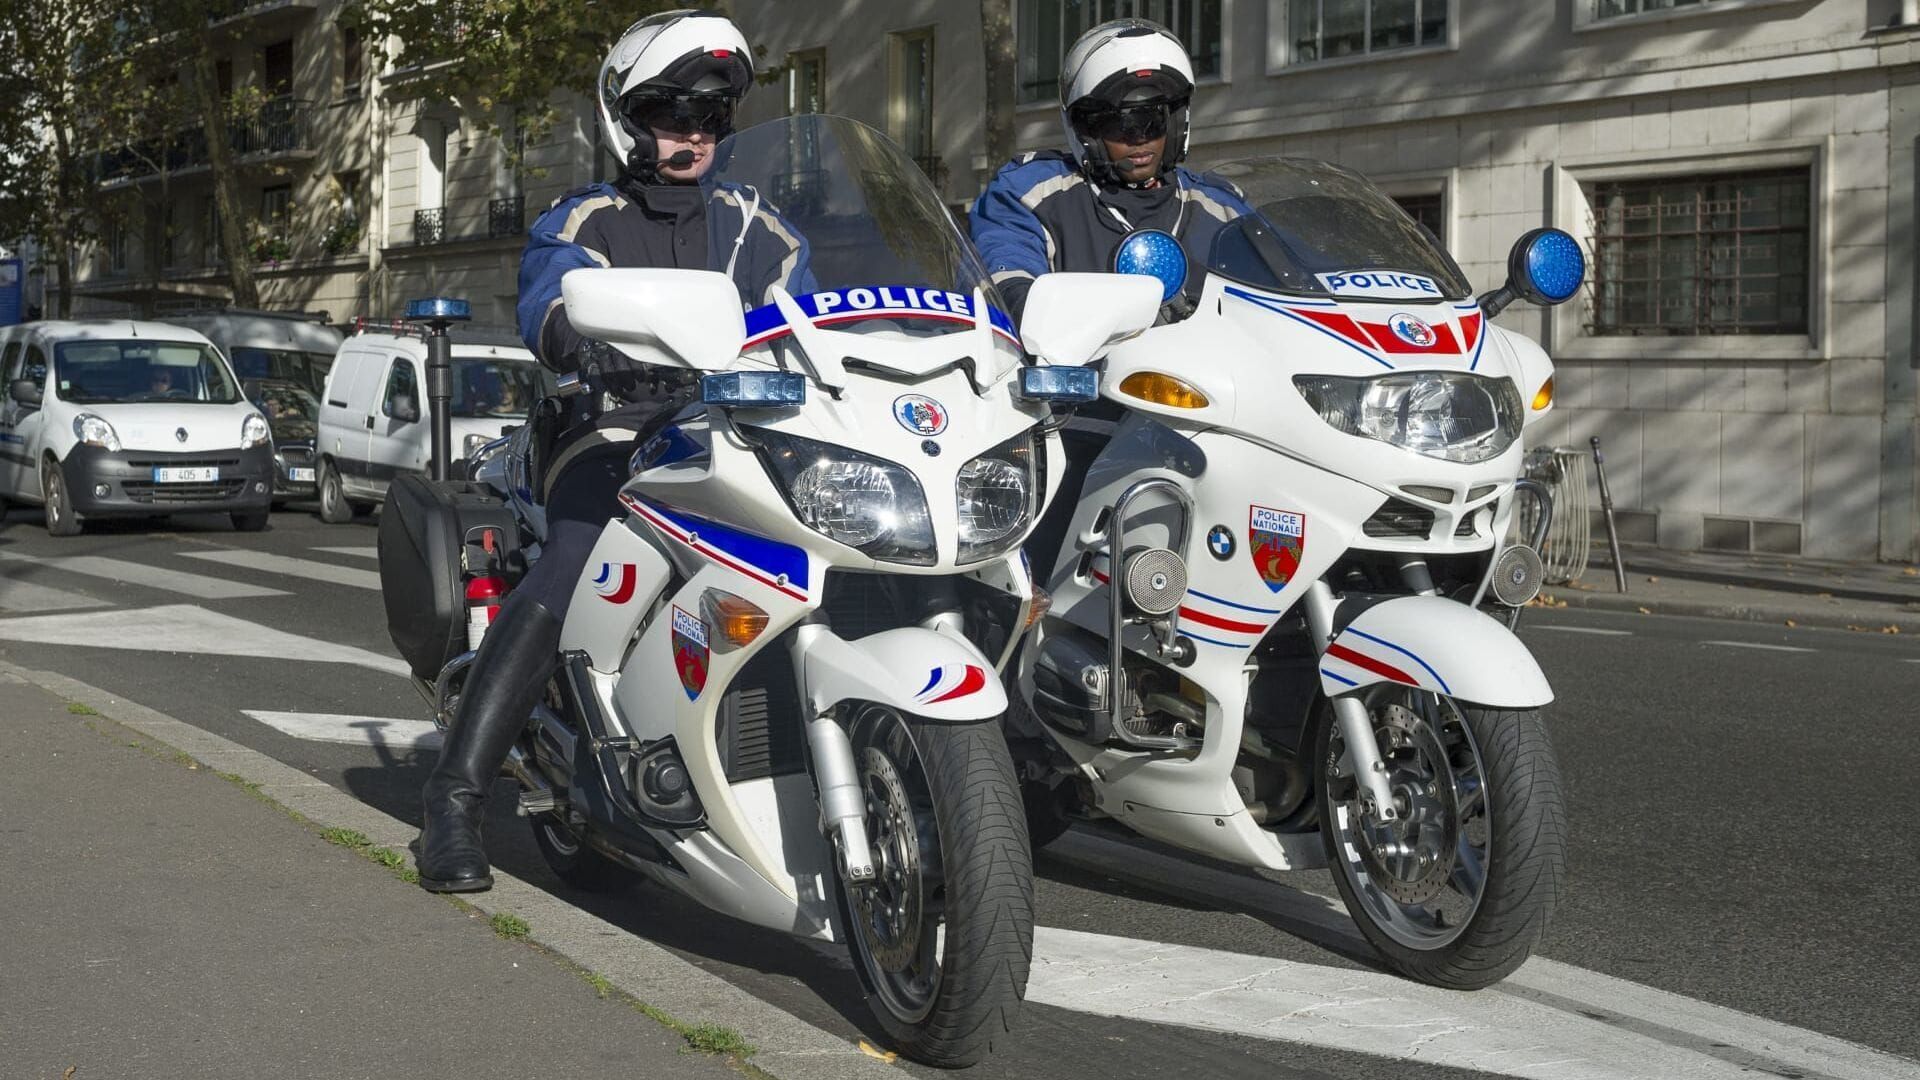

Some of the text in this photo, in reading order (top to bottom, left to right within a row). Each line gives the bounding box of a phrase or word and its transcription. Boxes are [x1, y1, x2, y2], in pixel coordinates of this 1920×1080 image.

[1326, 274, 1437, 293] POLICE
[813, 288, 969, 315] POLICE
[1252, 519, 1301, 535] NATIONALE
[1257, 510, 1297, 525] POLICE
[674, 619, 707, 645] NATIONALE
[677, 611, 705, 633] POLICE
